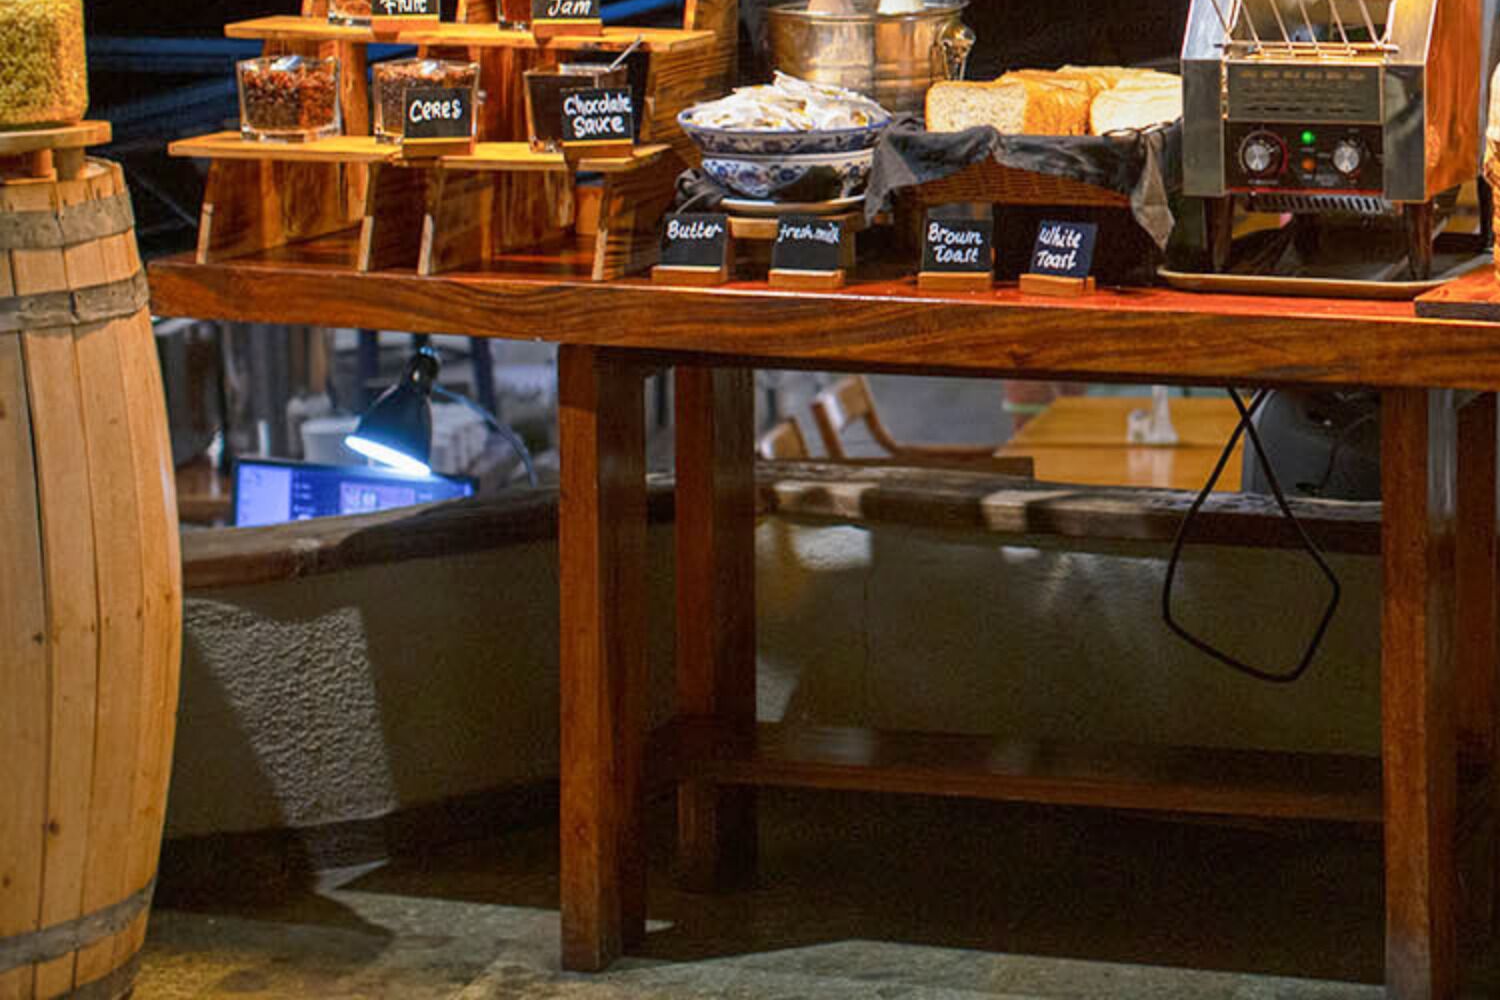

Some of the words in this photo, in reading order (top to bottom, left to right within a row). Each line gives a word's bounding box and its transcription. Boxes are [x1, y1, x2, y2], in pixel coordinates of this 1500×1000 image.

[563, 92, 632, 116] Chocolate
[573, 116, 625, 138] Sauce
[667, 219, 723, 240] Butter
[927, 222, 983, 245] Brown
[1039, 225, 1082, 248] White
[934, 244, 979, 263] Toast
[1036, 250, 1077, 270] Toast
